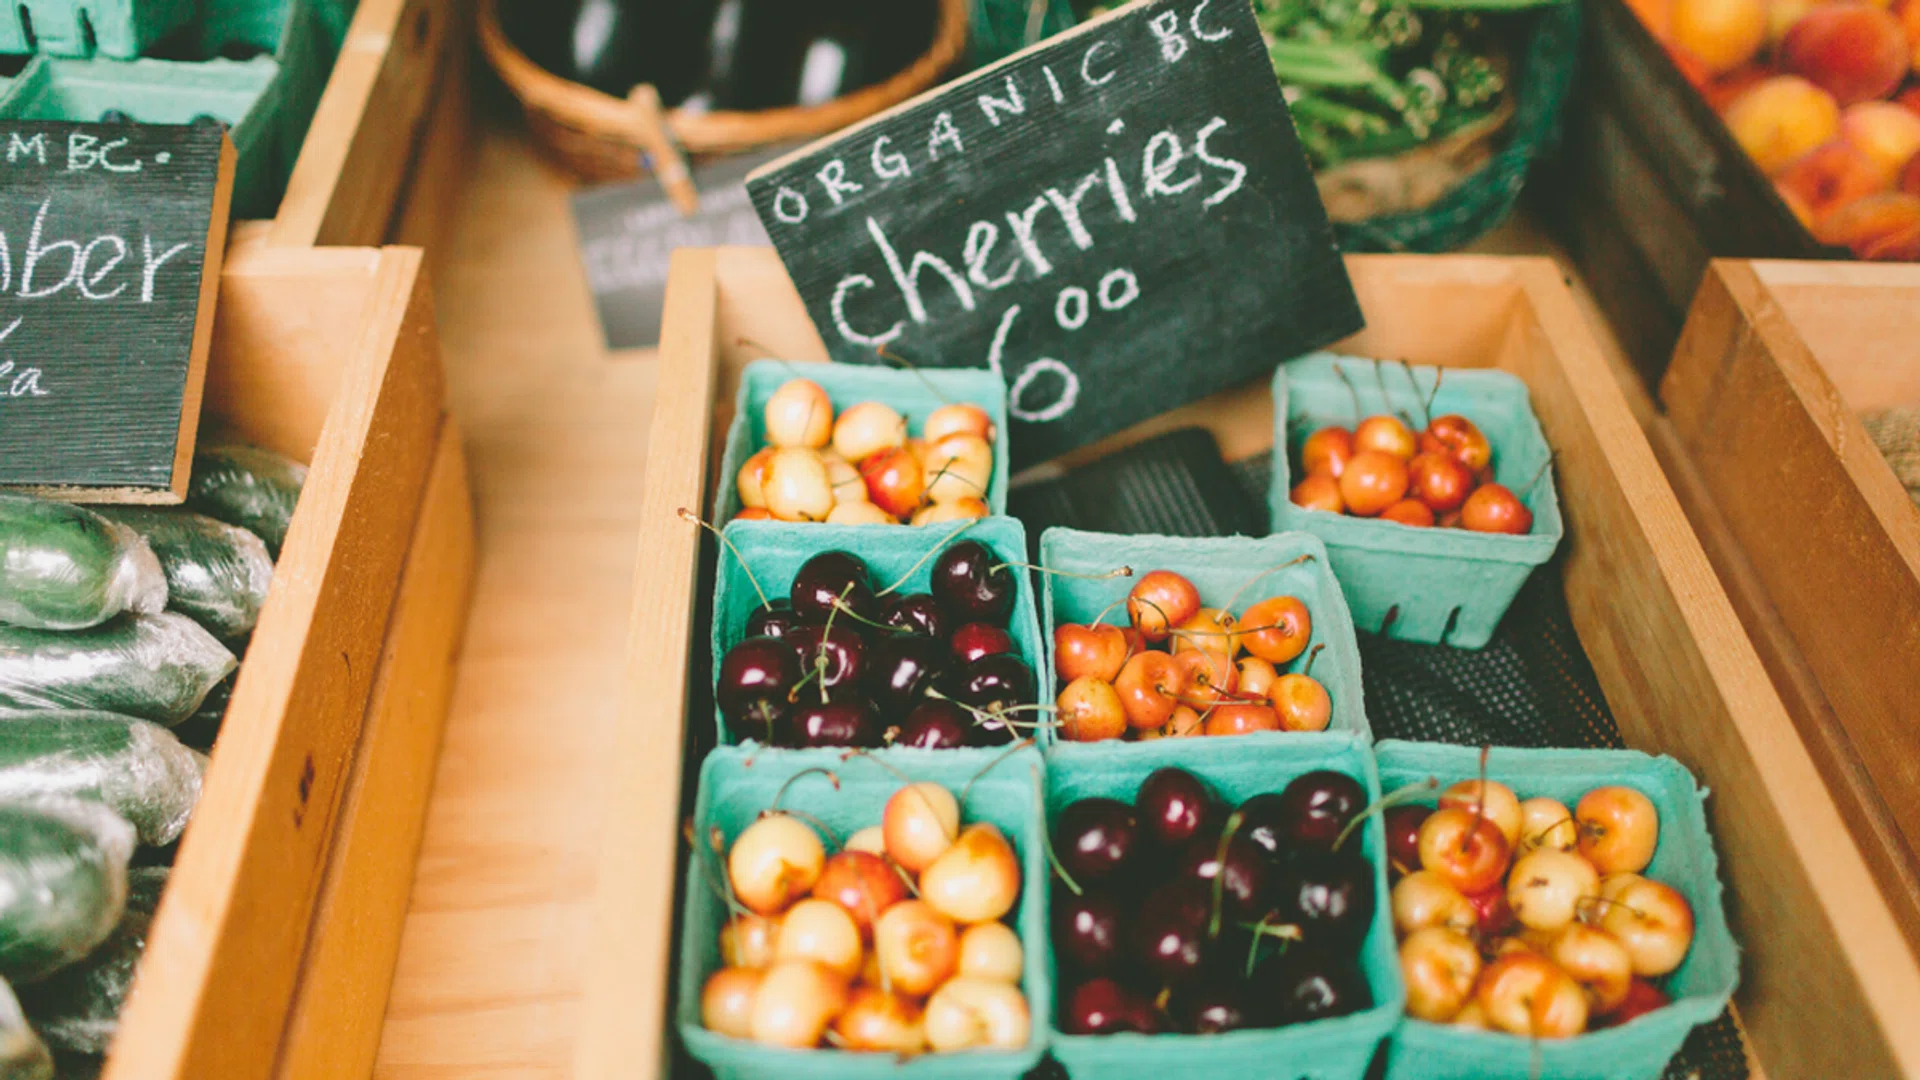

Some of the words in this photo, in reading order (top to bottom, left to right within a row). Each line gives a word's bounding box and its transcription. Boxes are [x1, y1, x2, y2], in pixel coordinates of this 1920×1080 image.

[772, 40, 1116, 224] ORGANIC
[1149, 0, 1233, 63] BC
[0, 196, 192, 302] ber
[831, 116, 1247, 345] cherries
